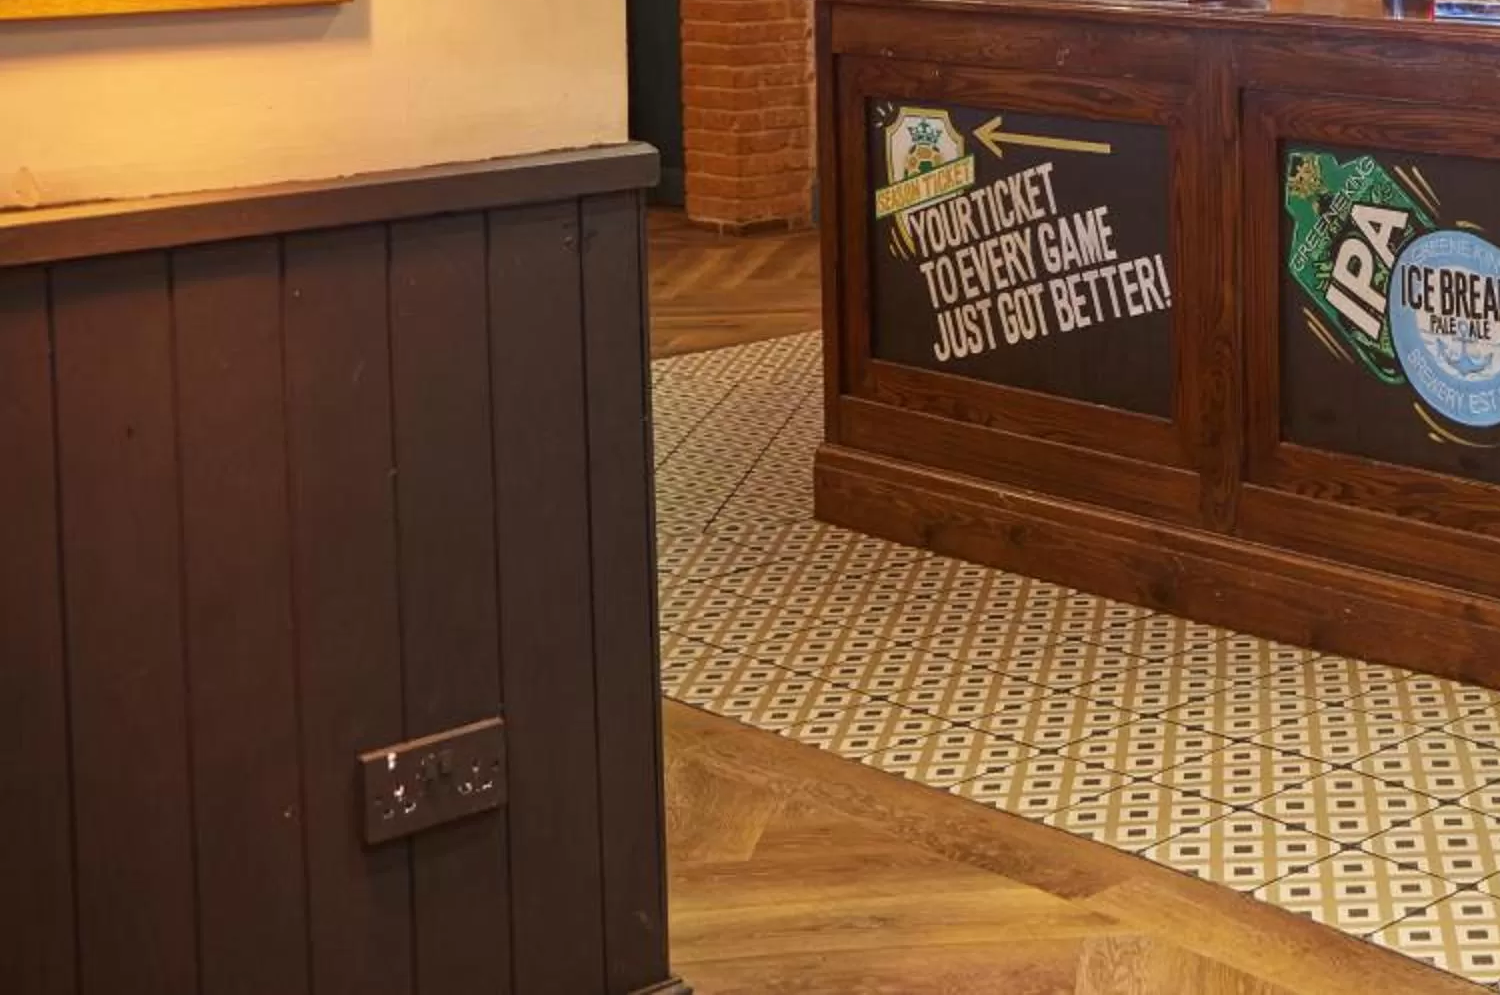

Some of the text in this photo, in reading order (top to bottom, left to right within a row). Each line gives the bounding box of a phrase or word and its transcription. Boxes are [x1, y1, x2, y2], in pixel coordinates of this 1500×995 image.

[909, 162, 1058, 257] YOUR TICKET
[920, 206, 1117, 308] TO EVERY GAME
[1290, 191, 1350, 272] GREENE
[933, 254, 1172, 362] JUST GOT BETTER!
[1325, 204, 1409, 340] IPA
[1401, 264, 1435, 313] ICE
[1429, 314, 1493, 340] PALE ALE
